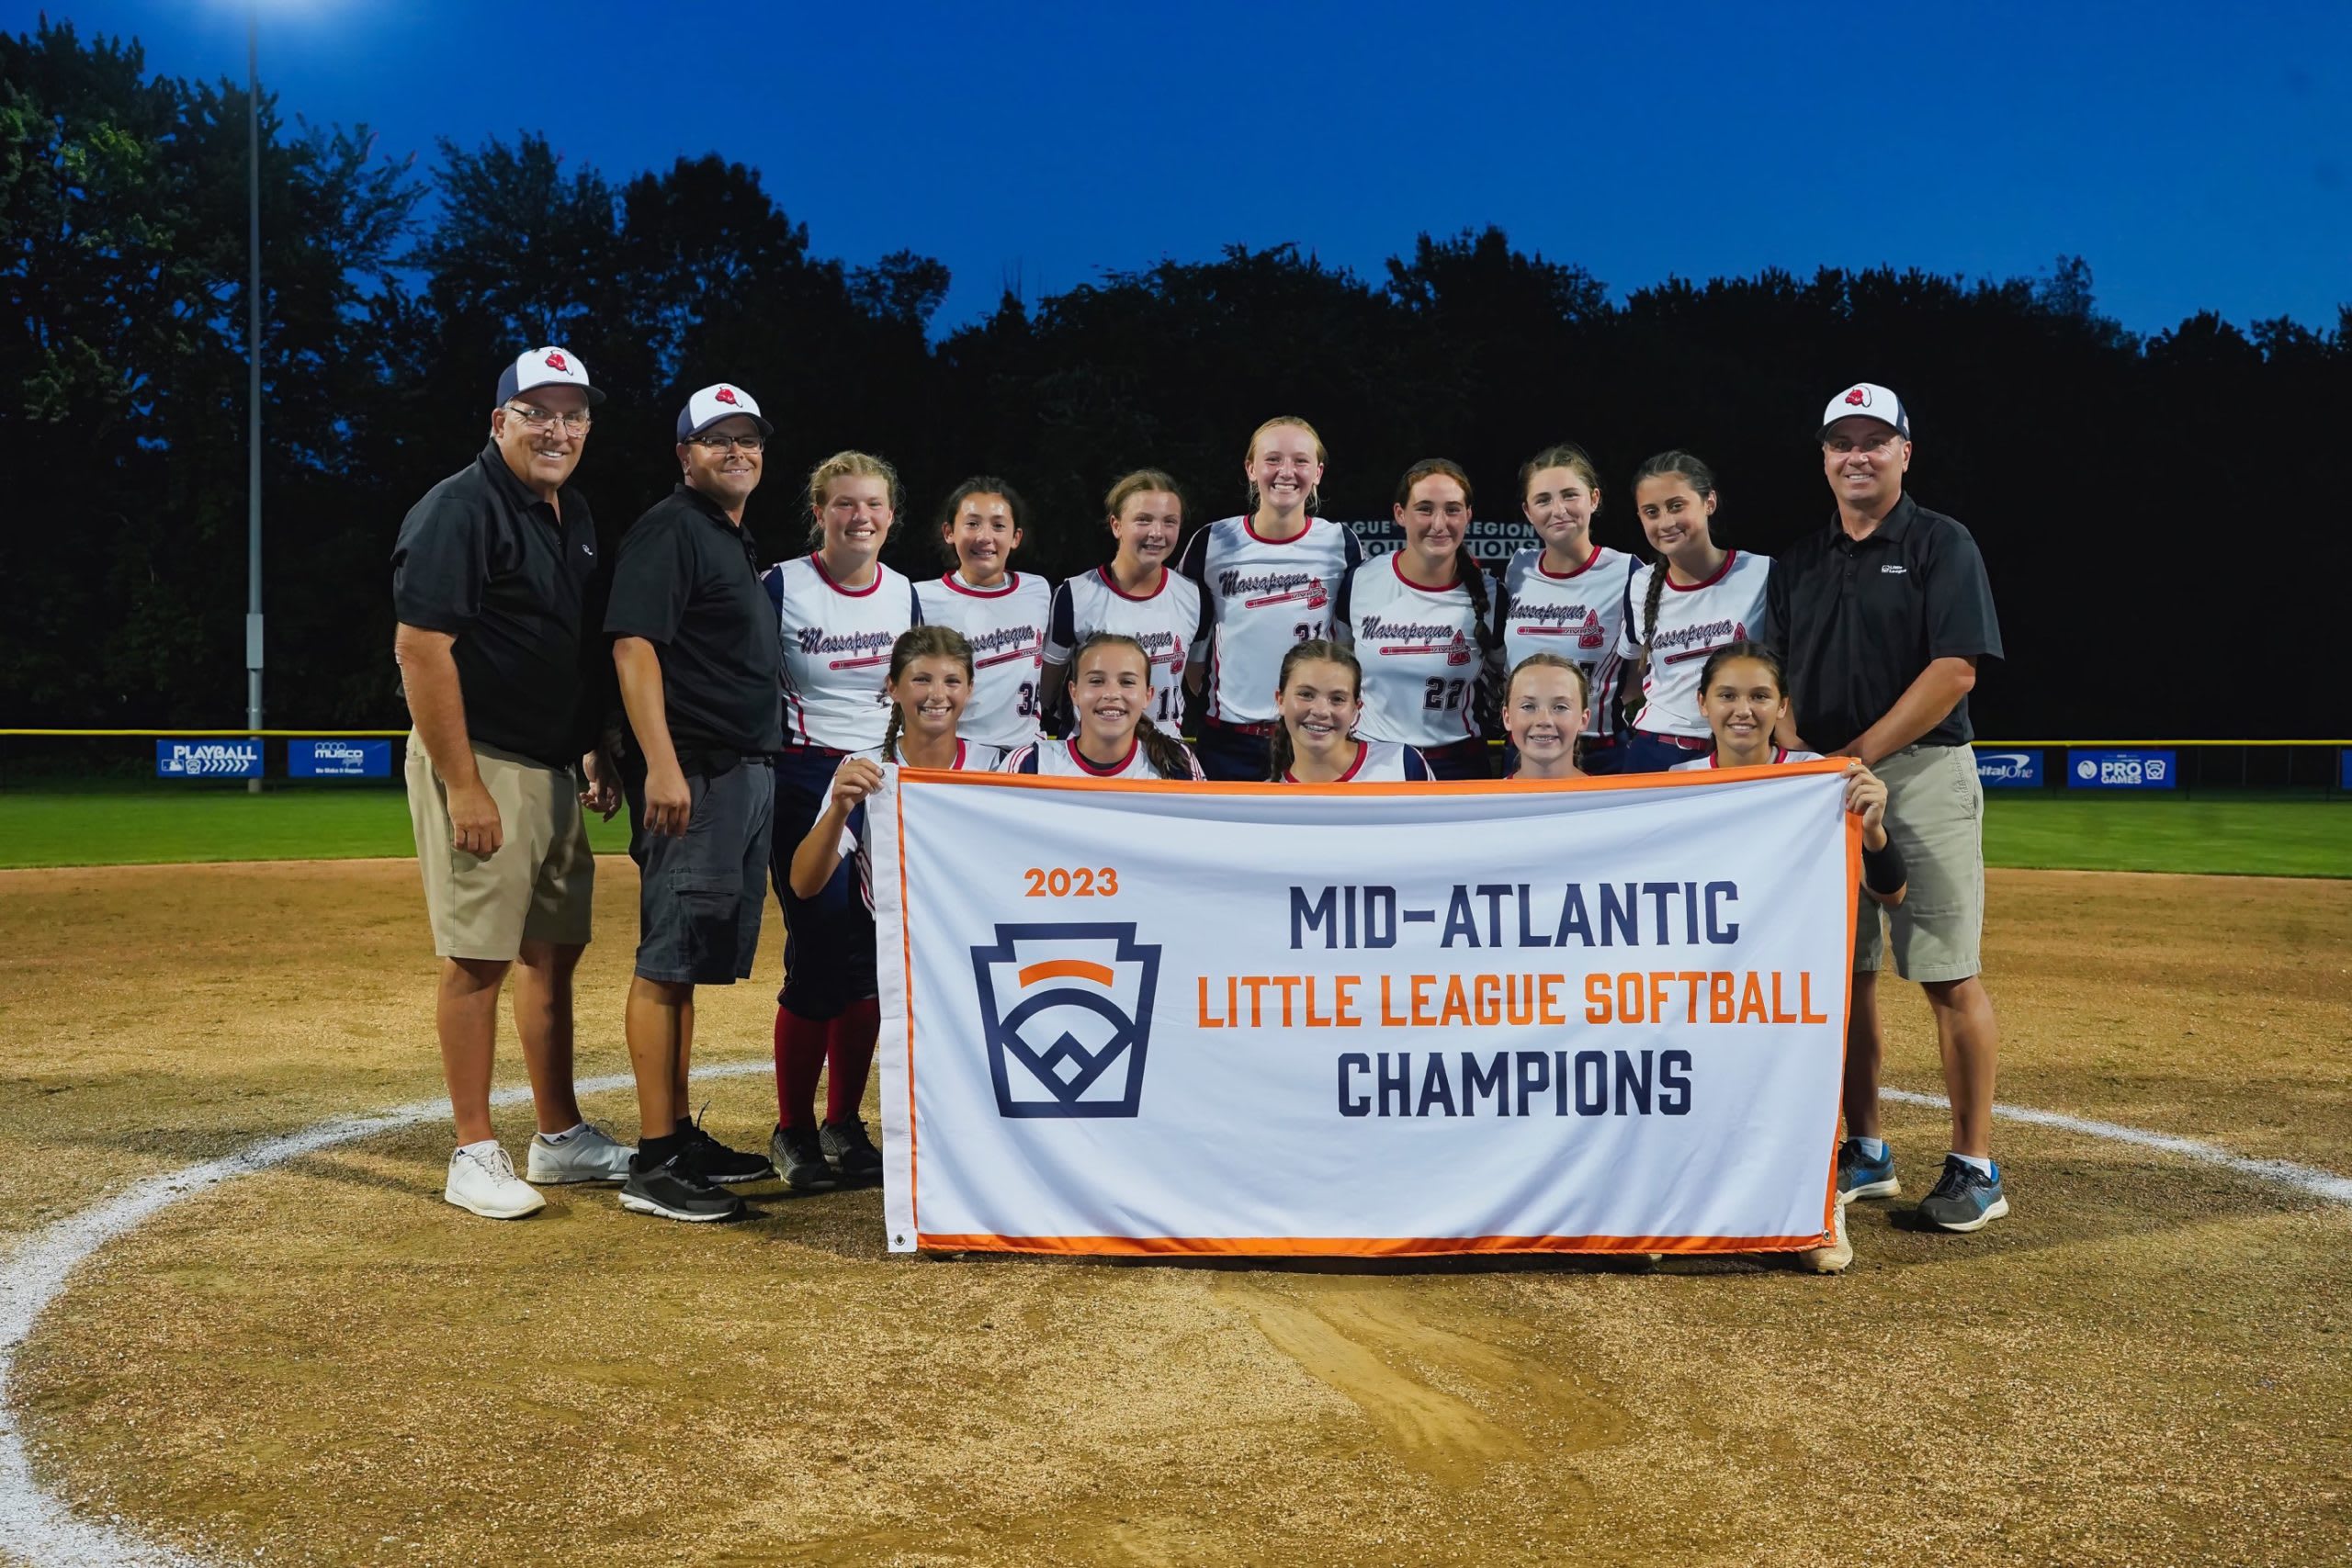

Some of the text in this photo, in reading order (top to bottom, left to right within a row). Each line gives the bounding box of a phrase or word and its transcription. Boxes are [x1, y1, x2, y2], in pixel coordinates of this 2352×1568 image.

[1218, 570, 1309, 596] Massapequa
[1362, 615, 1453, 645] Massapequa
[1423, 676, 1466, 711] 22
[2101, 762, 2143, 776] PRO
[2101, 775, 2143, 784] GAMES
[1024, 867, 1118, 897] 2023
[1289, 881, 1739, 949] MID-ATLANTIC
[1197, 970, 1828, 1028] LITTLE LEAGUE SOFTBALL
[1338, 1049, 1692, 1117] CHAMPIONS
